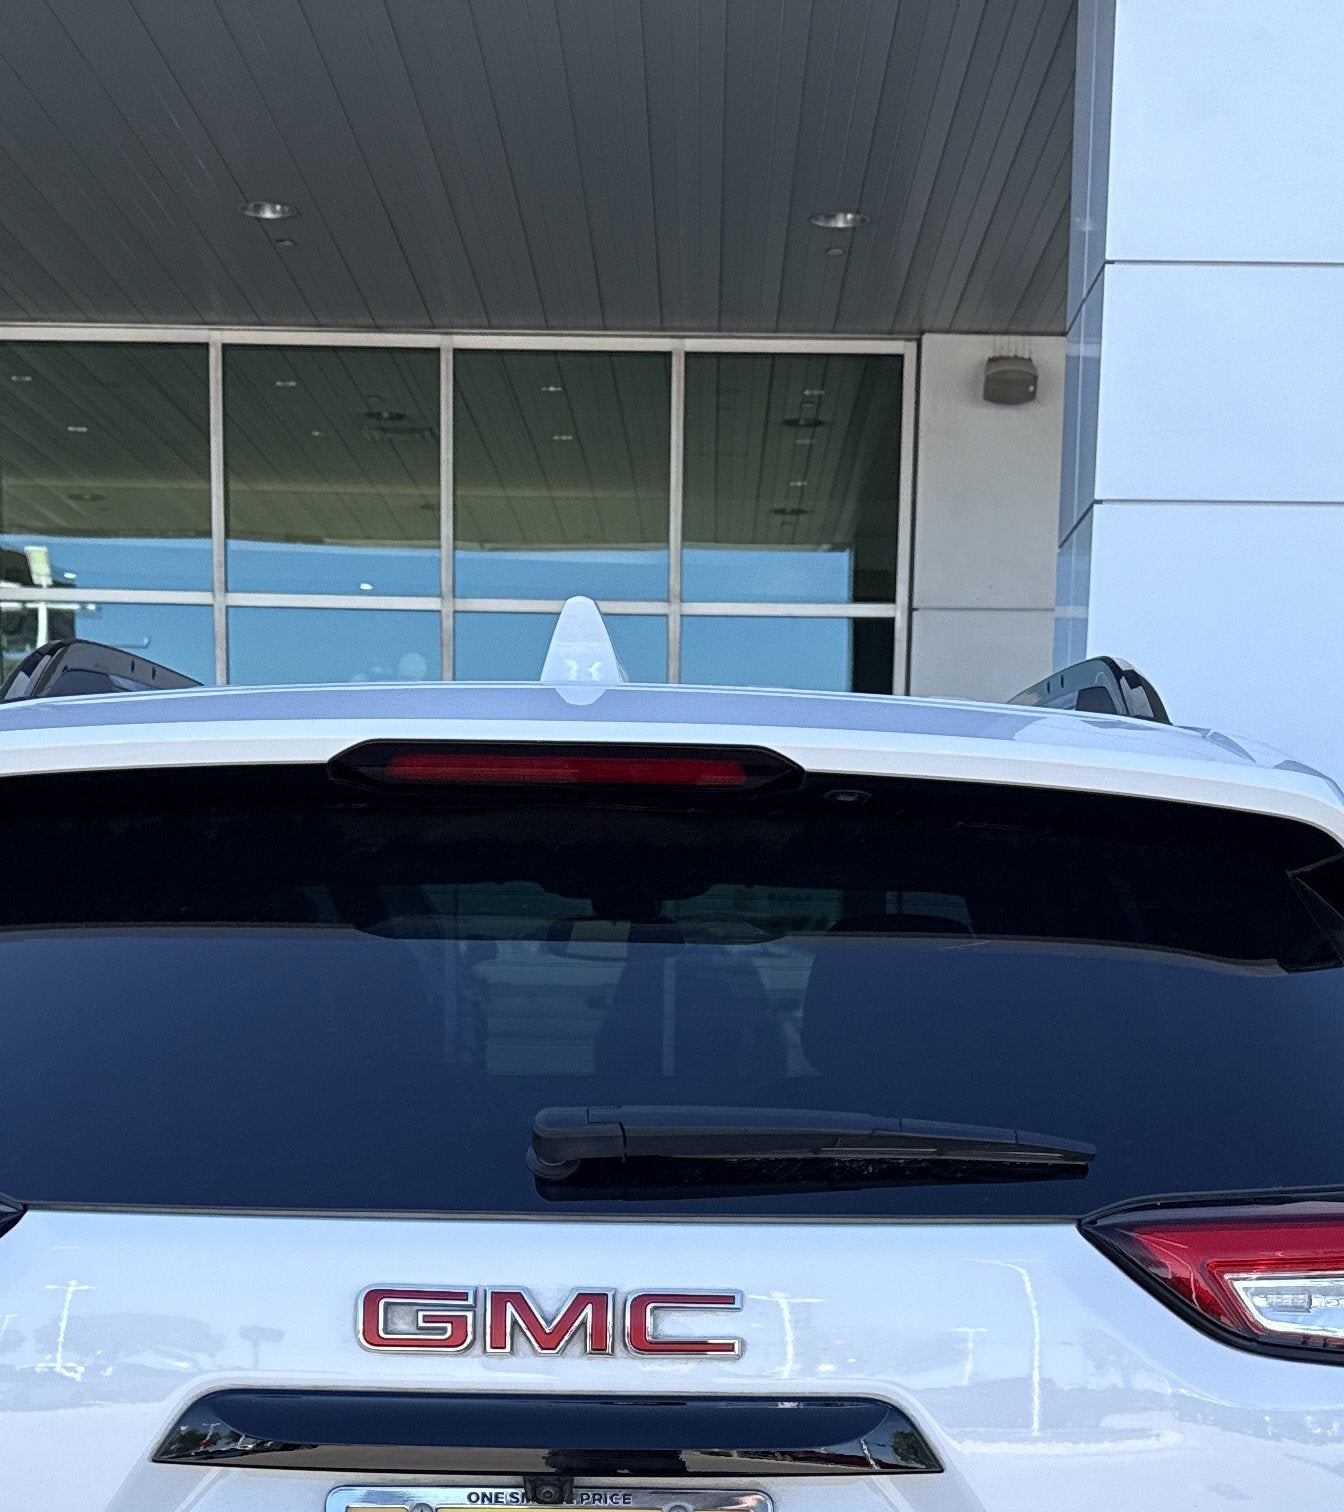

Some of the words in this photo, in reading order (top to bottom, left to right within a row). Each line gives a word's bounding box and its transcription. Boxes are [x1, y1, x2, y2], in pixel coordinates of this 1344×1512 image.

[357, 1284, 743, 1358] GMC
[467, 1491, 505, 1505] ONE
[580, 1492, 633, 1506] PRICE
